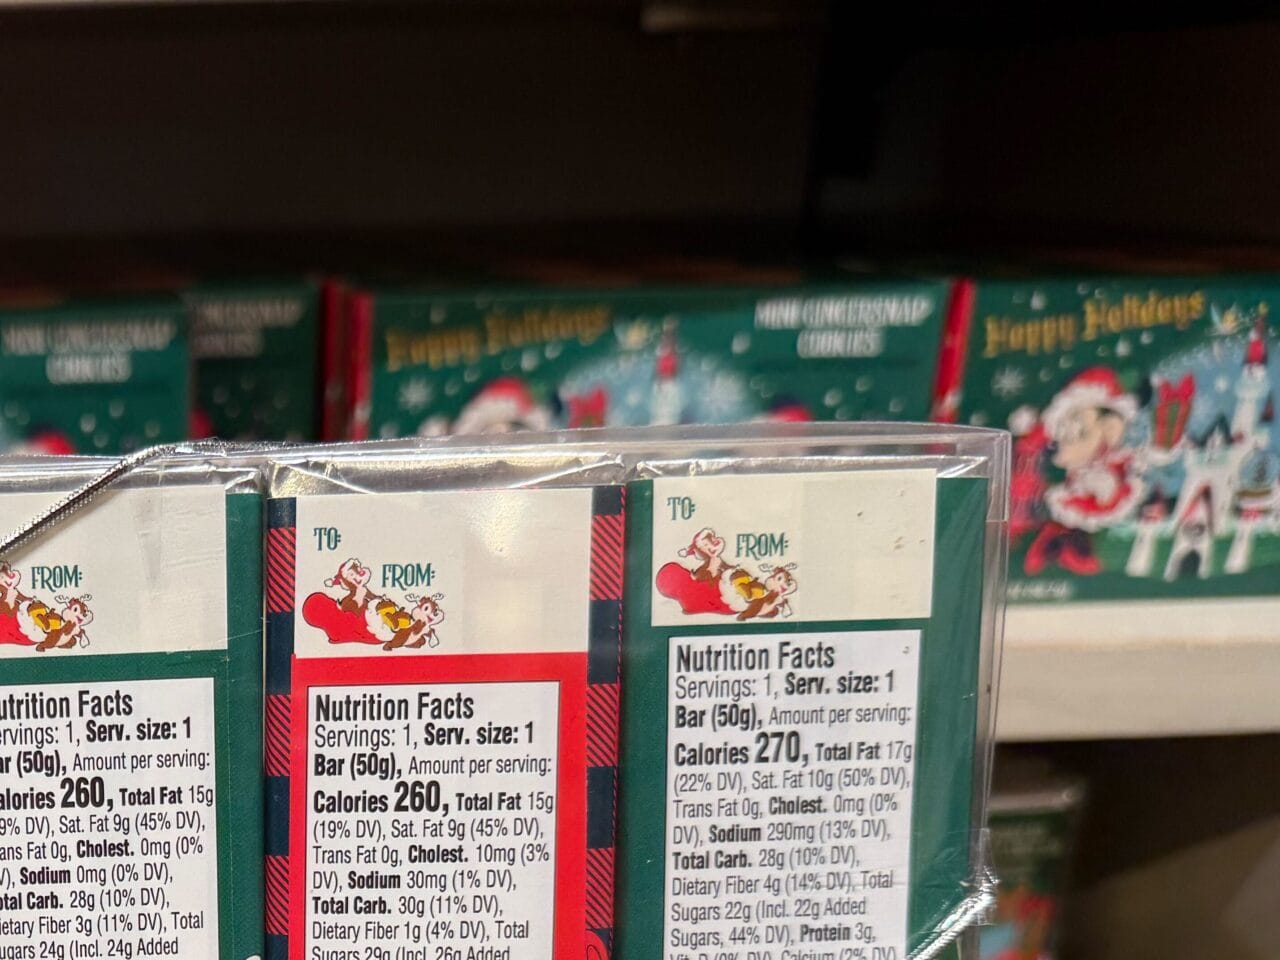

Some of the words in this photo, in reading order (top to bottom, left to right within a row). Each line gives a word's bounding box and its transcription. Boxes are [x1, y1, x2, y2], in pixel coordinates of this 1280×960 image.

[984, 314, 1077, 357] Happy
[1083, 290, 1205, 341] Holidays
[797, 327, 883, 358] COOKIES
[667, 497, 696, 520] TO:
[314, 527, 341, 551] TO:
[736, 533, 789, 560] FROM:
[31, 565, 83, 592] FROM:
[382, 563, 435, 590] FROM:
[676, 644, 769, 673] Nutrition
[778, 642, 835, 669] Facts
[675, 675, 757, 700] Servings:
[764, 674, 778, 699] 1,
[784, 672, 830, 696] Serv.
[836, 671, 879, 694] size:
[885, 670, 894, 691] 1
[78, 690, 133, 716] Facts
[315, 693, 409, 722] Nutrition
[417, 692, 474, 720] Facts
[65, 721, 80, 746] 1,
[86, 719, 130, 742] Serv.
[136, 717, 177, 741] size:
[182, 717, 192, 738] 1
[675, 705, 706, 728] Bar
[711, 704, 763, 732] (50g),
[769, 706, 824, 725] Amount
[828, 708, 851, 728] per
[855, 705, 912, 727] serving:
[314, 724, 396, 750] Servings:
[402, 723, 418, 748] 1,
[423, 722, 470, 745] Serv.
[476, 722, 519, 745] size:
[524, 721, 533, 743] 1
[674, 743, 748, 766] Calories
[755, 731, 809, 767] 270,
[815, 742, 854, 761] Total
[856, 741, 880, 760] Fat
[887, 741, 912, 762] 17g
[17, 750, 67, 777] (50g),
[73, 752, 127, 771] Amount
[131, 754, 152, 773] per
[156, 751, 210, 771] serving:
[314, 753, 345, 776] Bar
[350, 752, 402, 780] (50g),
[408, 755, 465, 775] Amount
[469, 757, 492, 778] per
[495, 755, 552, 777] serving:
[60, 777, 114, 811] 260,
[119, 789, 156, 806] Total
[159, 787, 182, 805] Fat
[188, 786, 213, 806] 15g
[314, 790, 388, 813] Calories
[394, 780, 449, 816] 260,
[456, 793, 493, 811] Total
[497, 792, 521, 811] Fat
[528, 792, 554, 813] 15g
